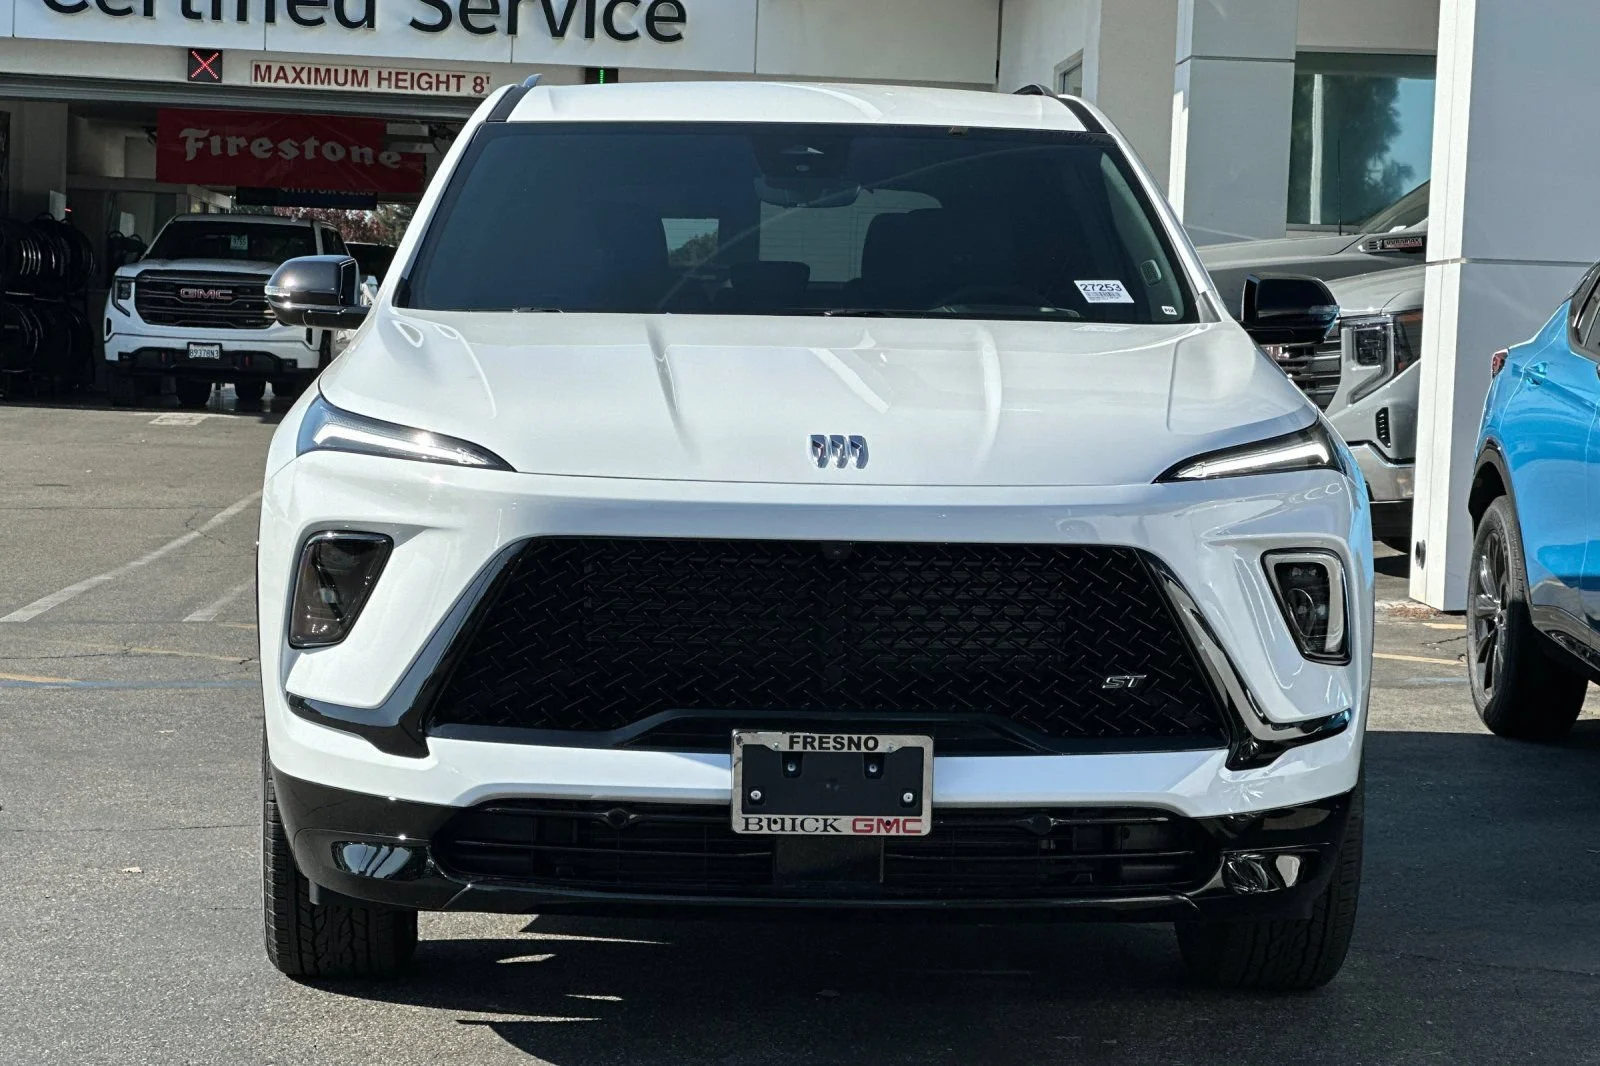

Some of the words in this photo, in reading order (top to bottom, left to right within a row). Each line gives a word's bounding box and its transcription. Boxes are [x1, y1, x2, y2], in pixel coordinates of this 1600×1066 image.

[253, 63, 370, 89] MAXIMUM
[377, 70, 466, 93] HEIGHT
[179, 127, 402, 169] Firestone
[180, 287, 233, 300] GMC
[1079, 283, 1123, 292] 27253
[1102, 674, 1147, 689] ST
[788, 735, 879, 751] FRESNO
[741, 816, 844, 833] BUICK
[852, 818, 923, 834] GMC
